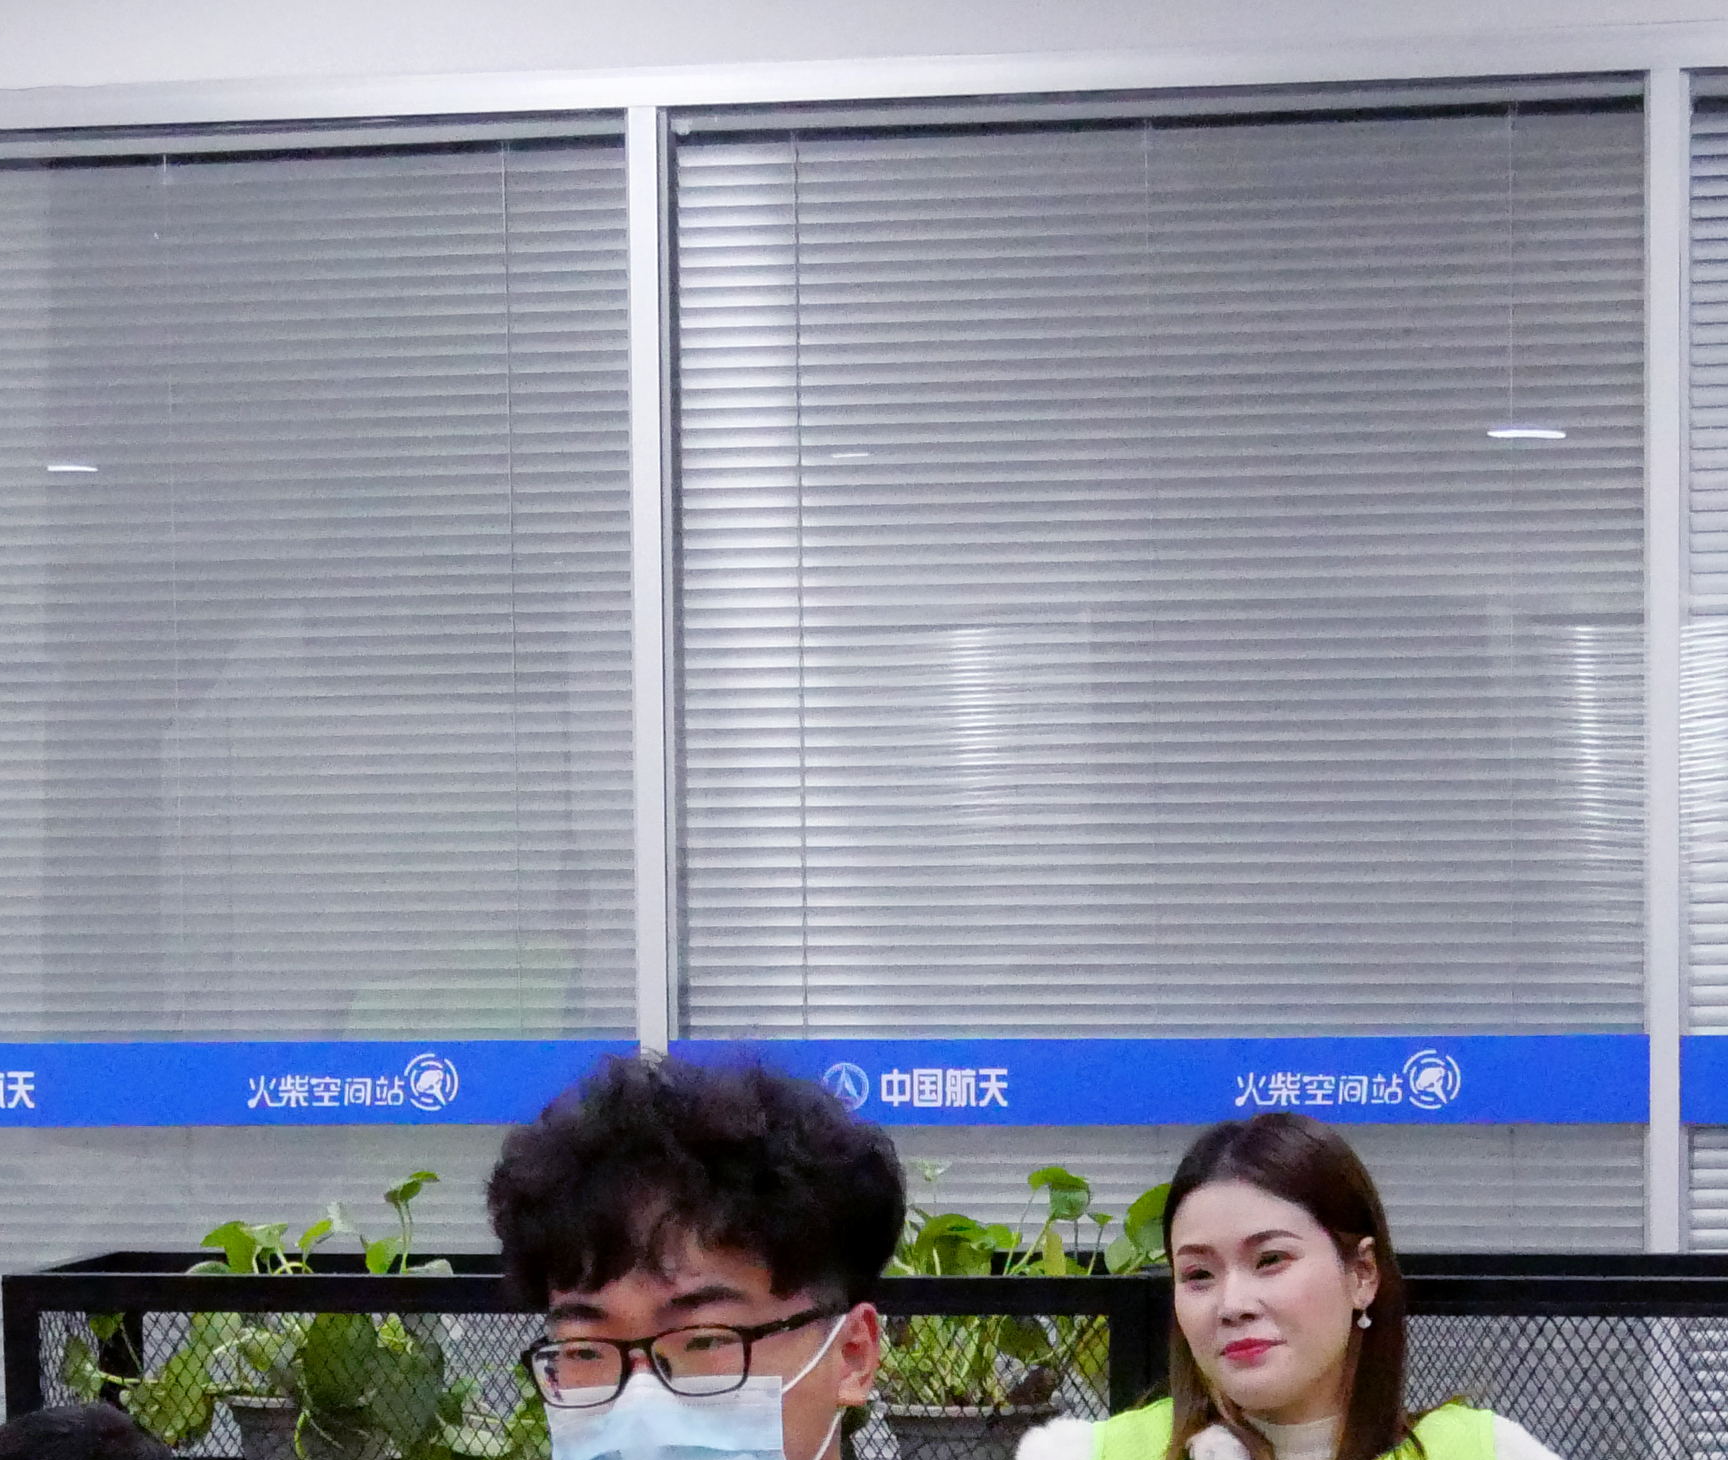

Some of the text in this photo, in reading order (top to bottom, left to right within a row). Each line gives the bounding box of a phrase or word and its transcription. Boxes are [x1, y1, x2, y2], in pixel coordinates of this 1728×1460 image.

[247, 1074, 405, 1109] 火柴空间站
[880, 1067, 1009, 1108] 中国航天
[1234, 1071, 1403, 1107] 火柴空间站
